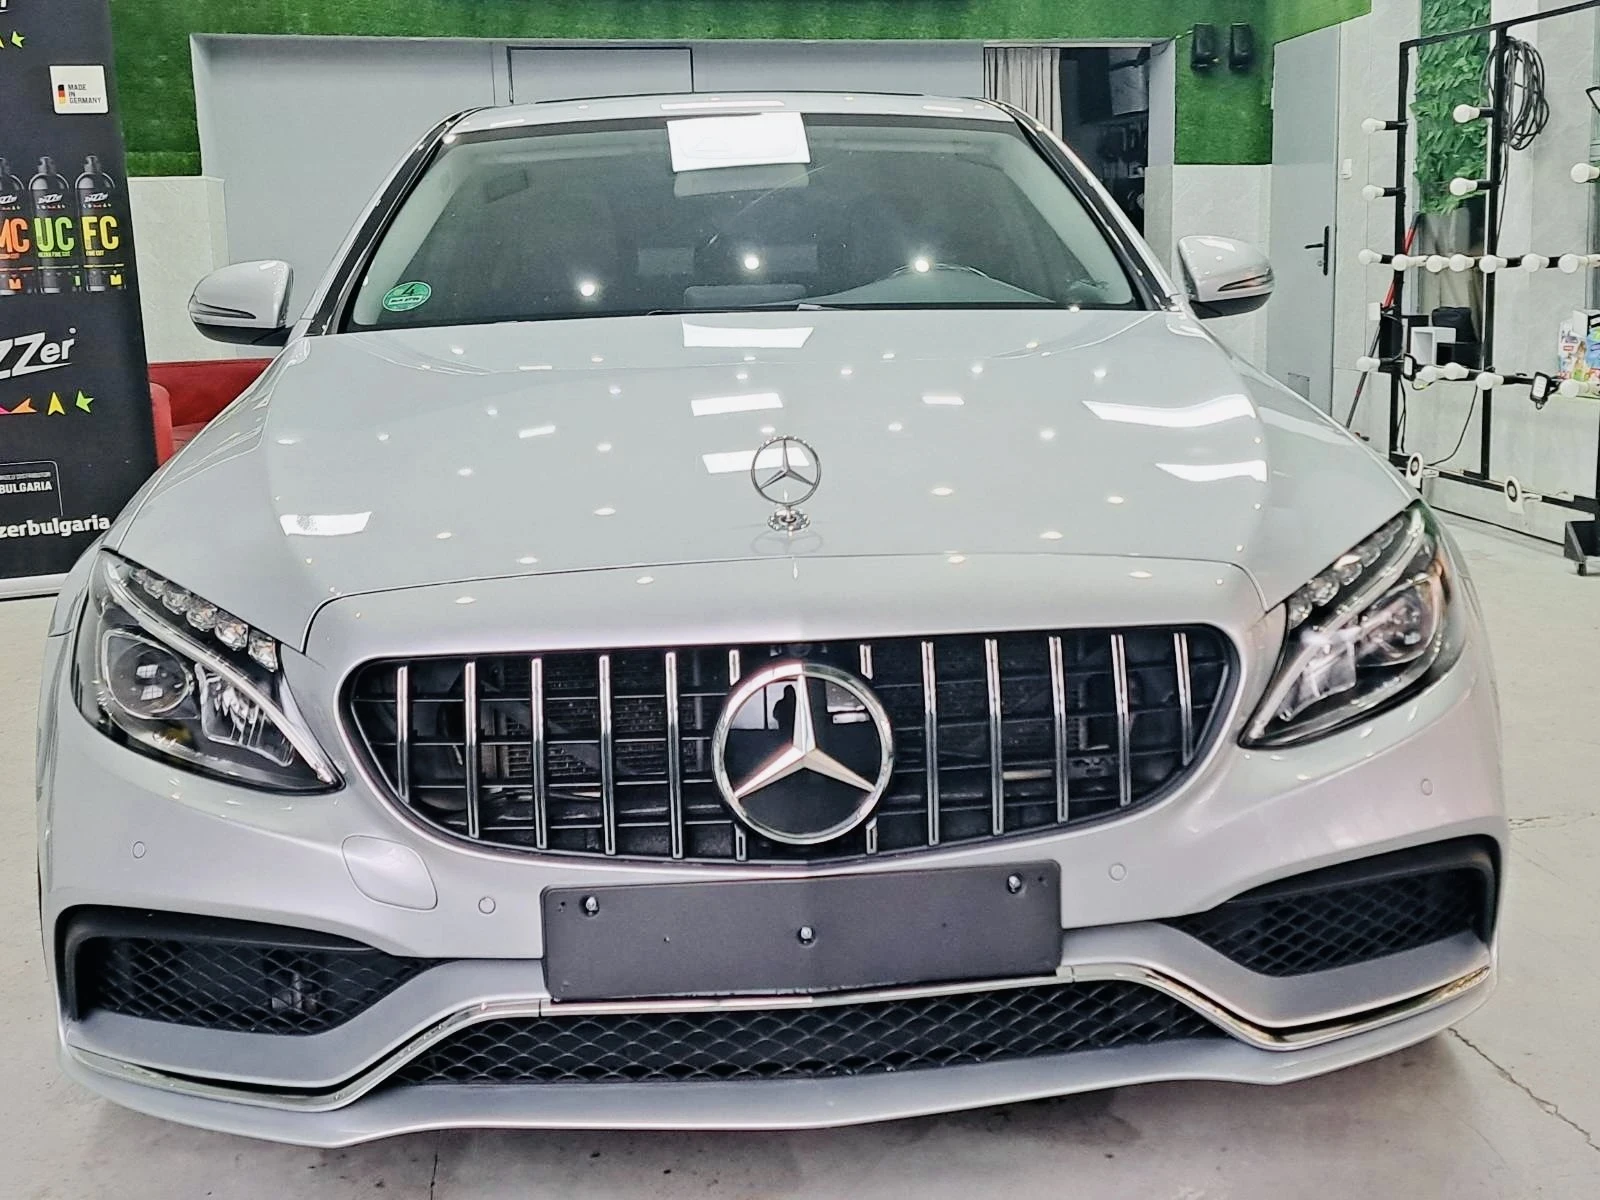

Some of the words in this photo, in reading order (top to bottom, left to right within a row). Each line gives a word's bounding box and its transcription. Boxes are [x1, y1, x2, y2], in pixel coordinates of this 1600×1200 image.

[34, 217, 75, 252] UC
[82, 216, 119, 250] FC
[401, 284, 416, 296] 4
[0, 481, 52, 494] BULGARIA
